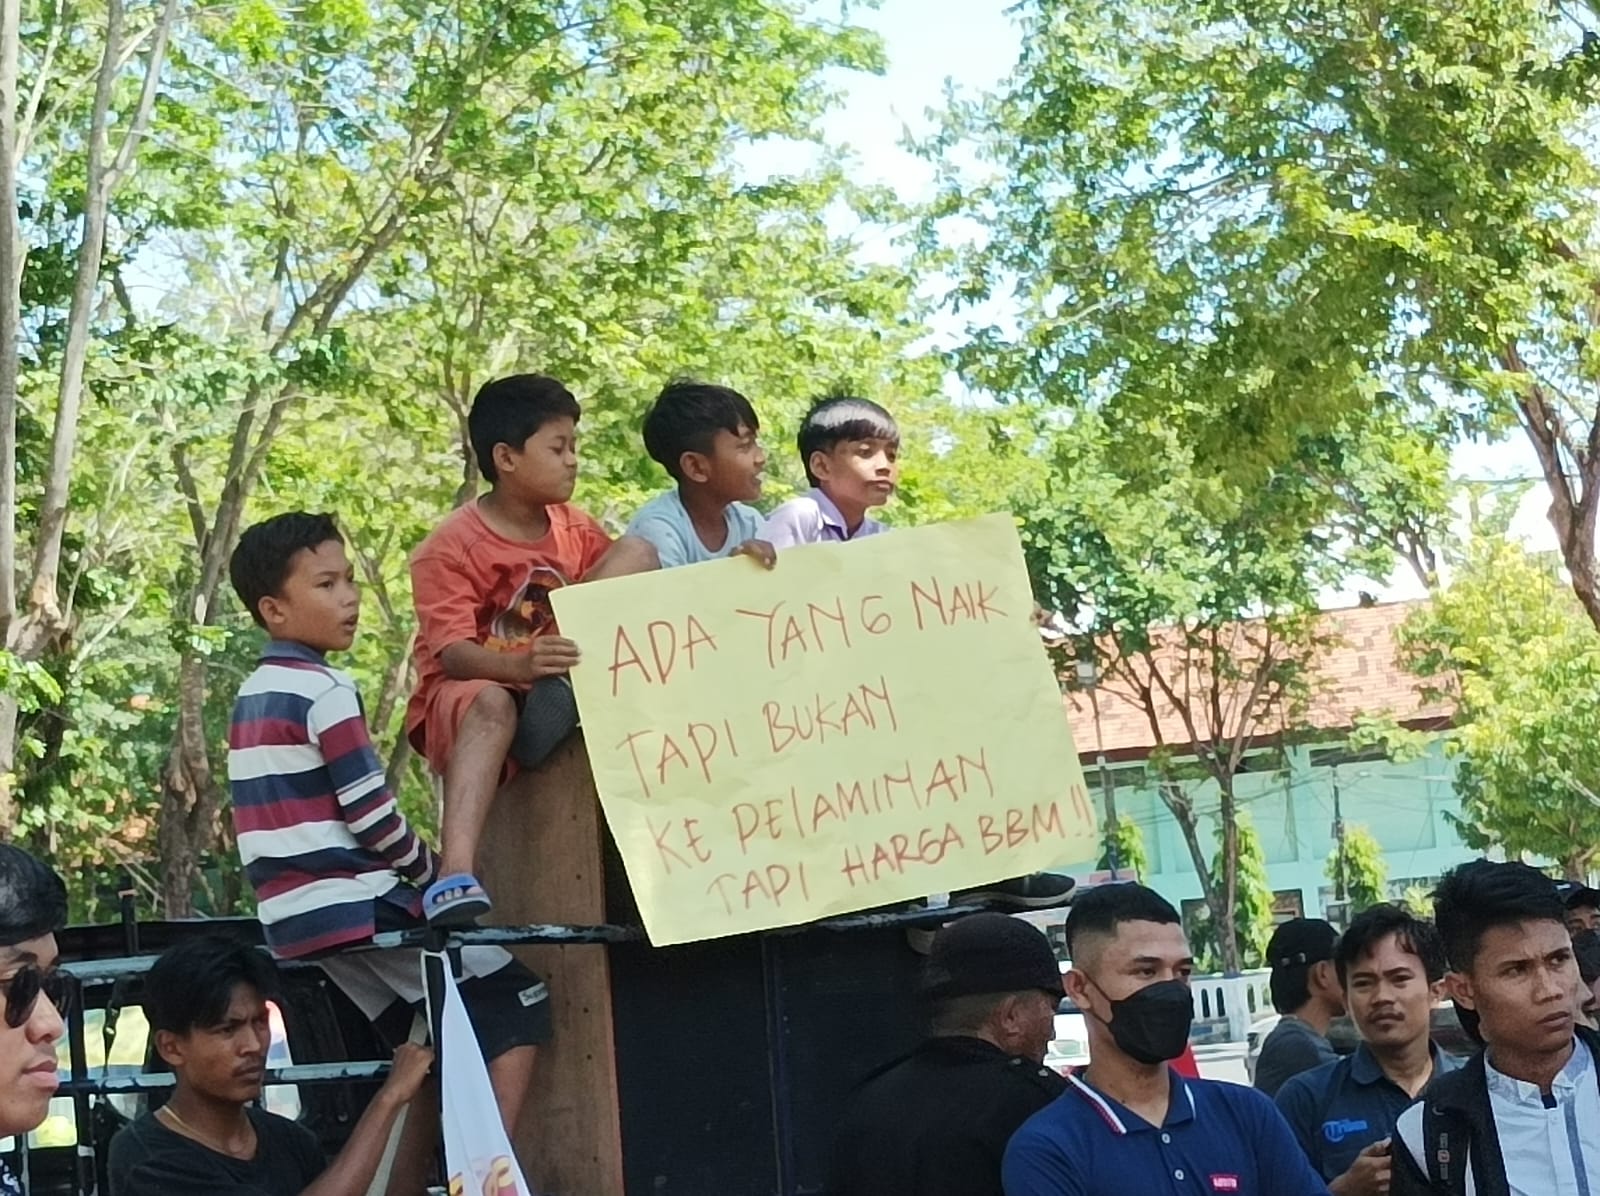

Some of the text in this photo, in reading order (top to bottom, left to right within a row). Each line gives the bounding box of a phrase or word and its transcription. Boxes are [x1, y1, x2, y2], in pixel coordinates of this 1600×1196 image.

[608, 614, 717, 697] ADA
[911, 576, 1008, 630] NAIK
[615, 675, 897, 799] TAPI BUKAN
[646, 816, 712, 875] KE
[705, 861, 810, 916] TAPI
[841, 822, 965, 887] HARGA
